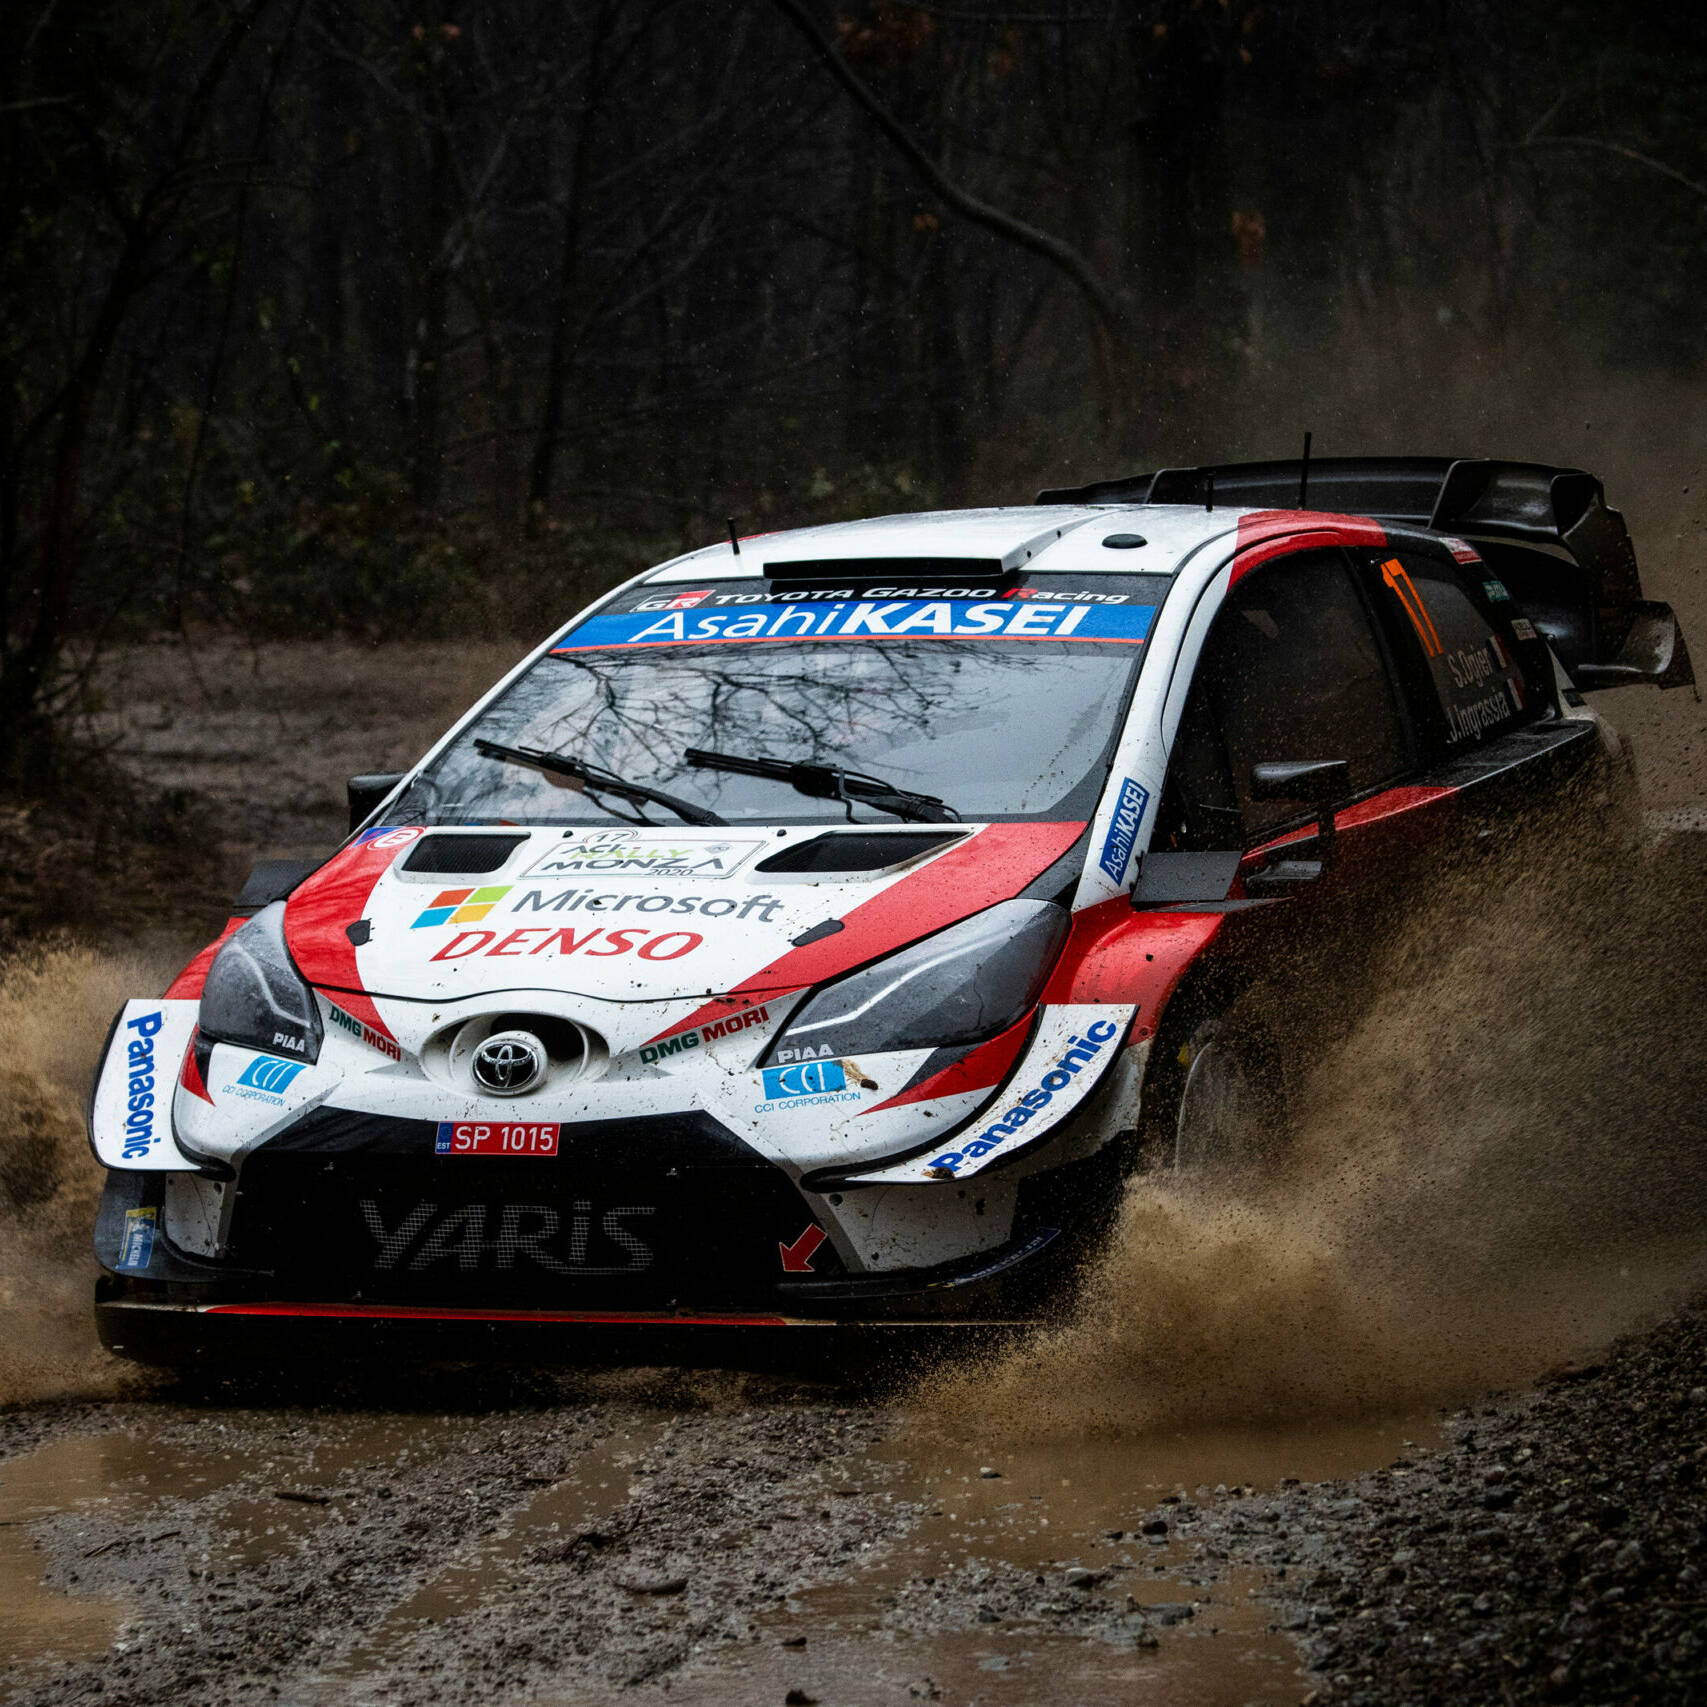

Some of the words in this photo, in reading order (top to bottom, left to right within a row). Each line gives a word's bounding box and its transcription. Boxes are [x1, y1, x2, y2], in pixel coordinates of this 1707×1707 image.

[637, 597, 701, 611] GR
[715, 589, 854, 605] TOYOTA
[861, 587, 997, 599] GAZOO
[1001, 588, 1130, 605] Racing
[597, 833, 631, 843] 17
[541, 858, 724, 870] MONZA
[644, 868, 693, 876] 2020
[511, 888, 786, 923] Microsoft
[429, 927, 704, 961] DENSO
[272, 1032, 305, 1052] PIAA
[329, 1005, 362, 1037] DMG
[363, 1026, 402, 1062] MORI
[639, 1032, 700, 1064] DMG
[701, 1006, 770, 1043] MORI
[777, 1044, 834, 1064] PIAA
[122, 1011, 162, 1159] Panasonic
[928, 1019, 1117, 1173] Panasonic
[754, 1103, 775, 1114] CCI
[779, 1091, 861, 1110] CORPORATION
[437, 1141, 451, 1150] EST
[455, 1126, 490, 1150] SP
[500, 1126, 554, 1151] 1015
